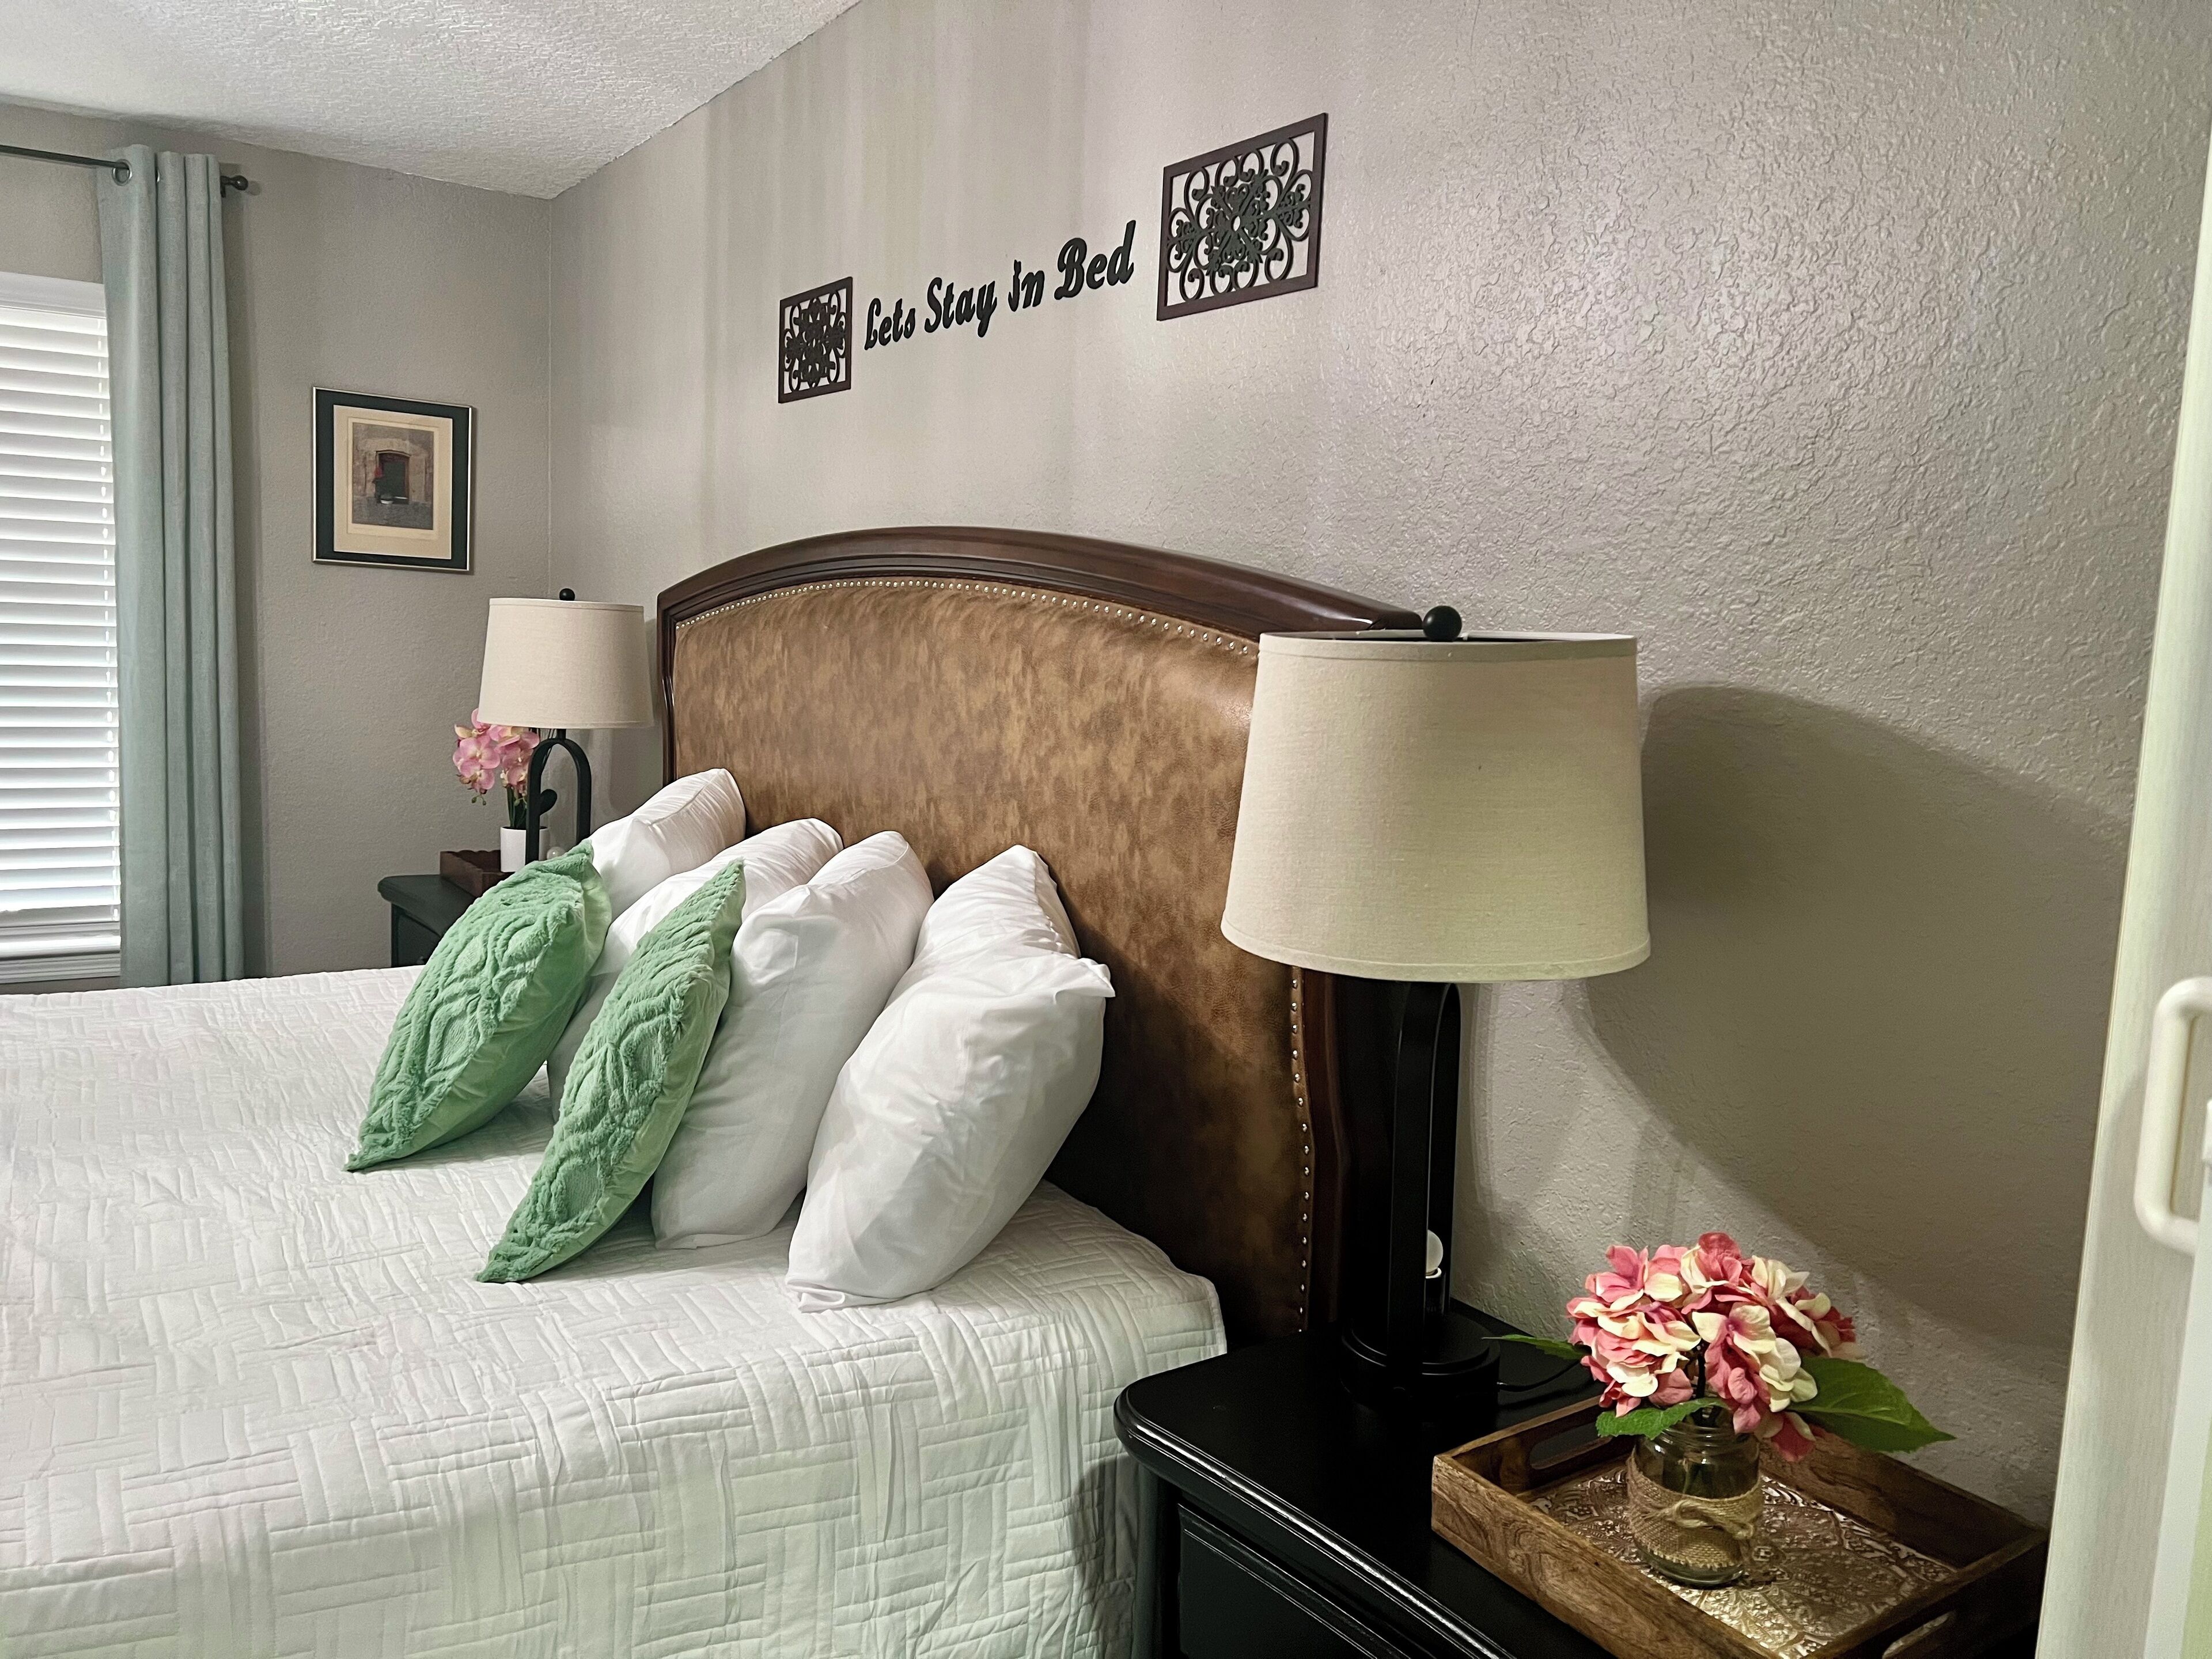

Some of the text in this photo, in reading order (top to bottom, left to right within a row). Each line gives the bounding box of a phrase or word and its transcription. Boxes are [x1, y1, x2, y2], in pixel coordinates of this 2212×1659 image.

[864, 219, 1137, 351] Lets Stay in Bed
